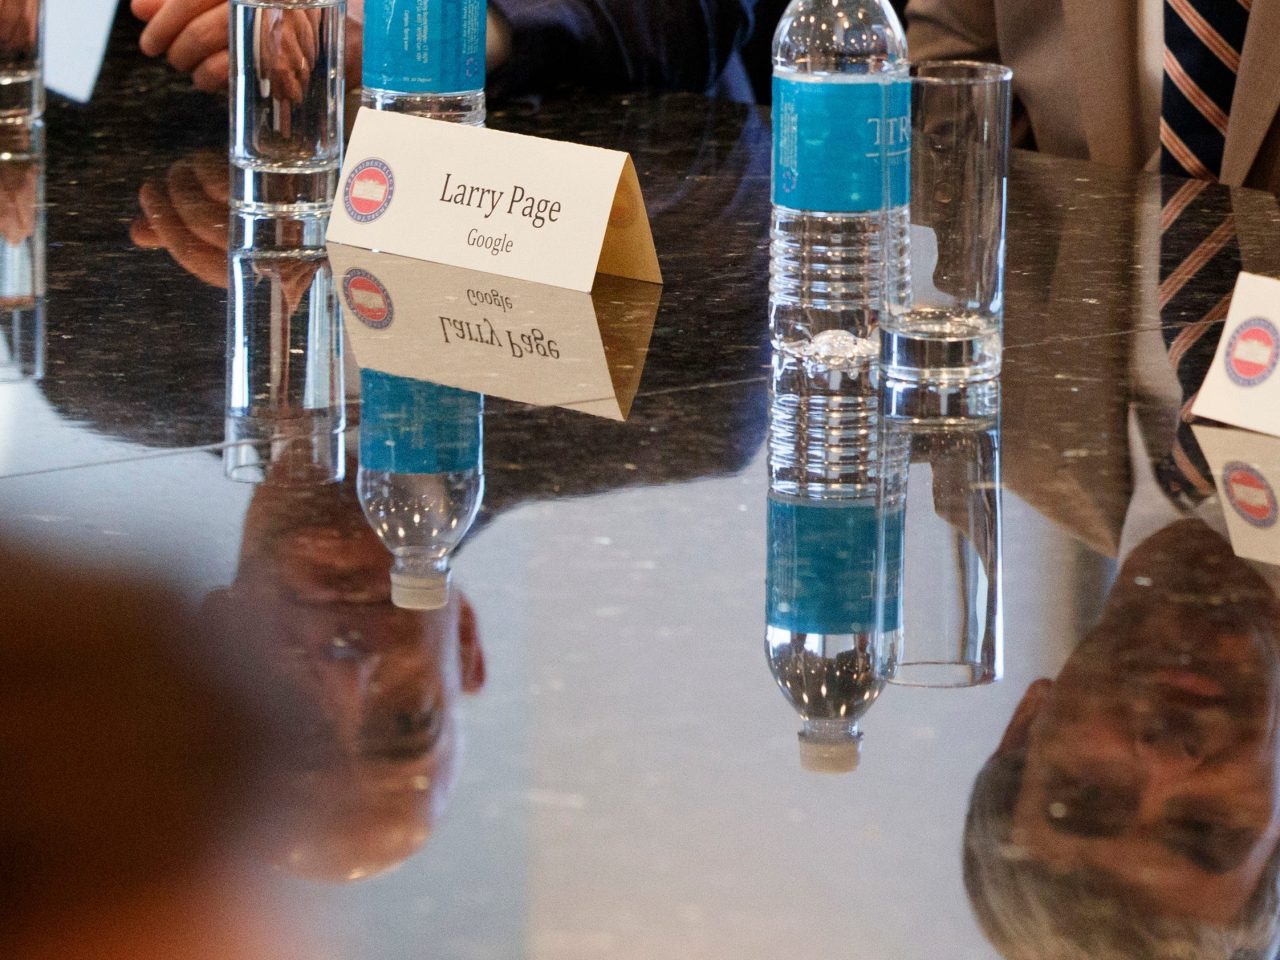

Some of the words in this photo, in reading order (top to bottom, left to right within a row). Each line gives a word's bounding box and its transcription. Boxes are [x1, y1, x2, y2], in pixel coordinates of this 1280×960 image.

[439, 173, 504, 219] Larry
[507, 185, 562, 229] Page
[466, 228, 515, 256] Google
